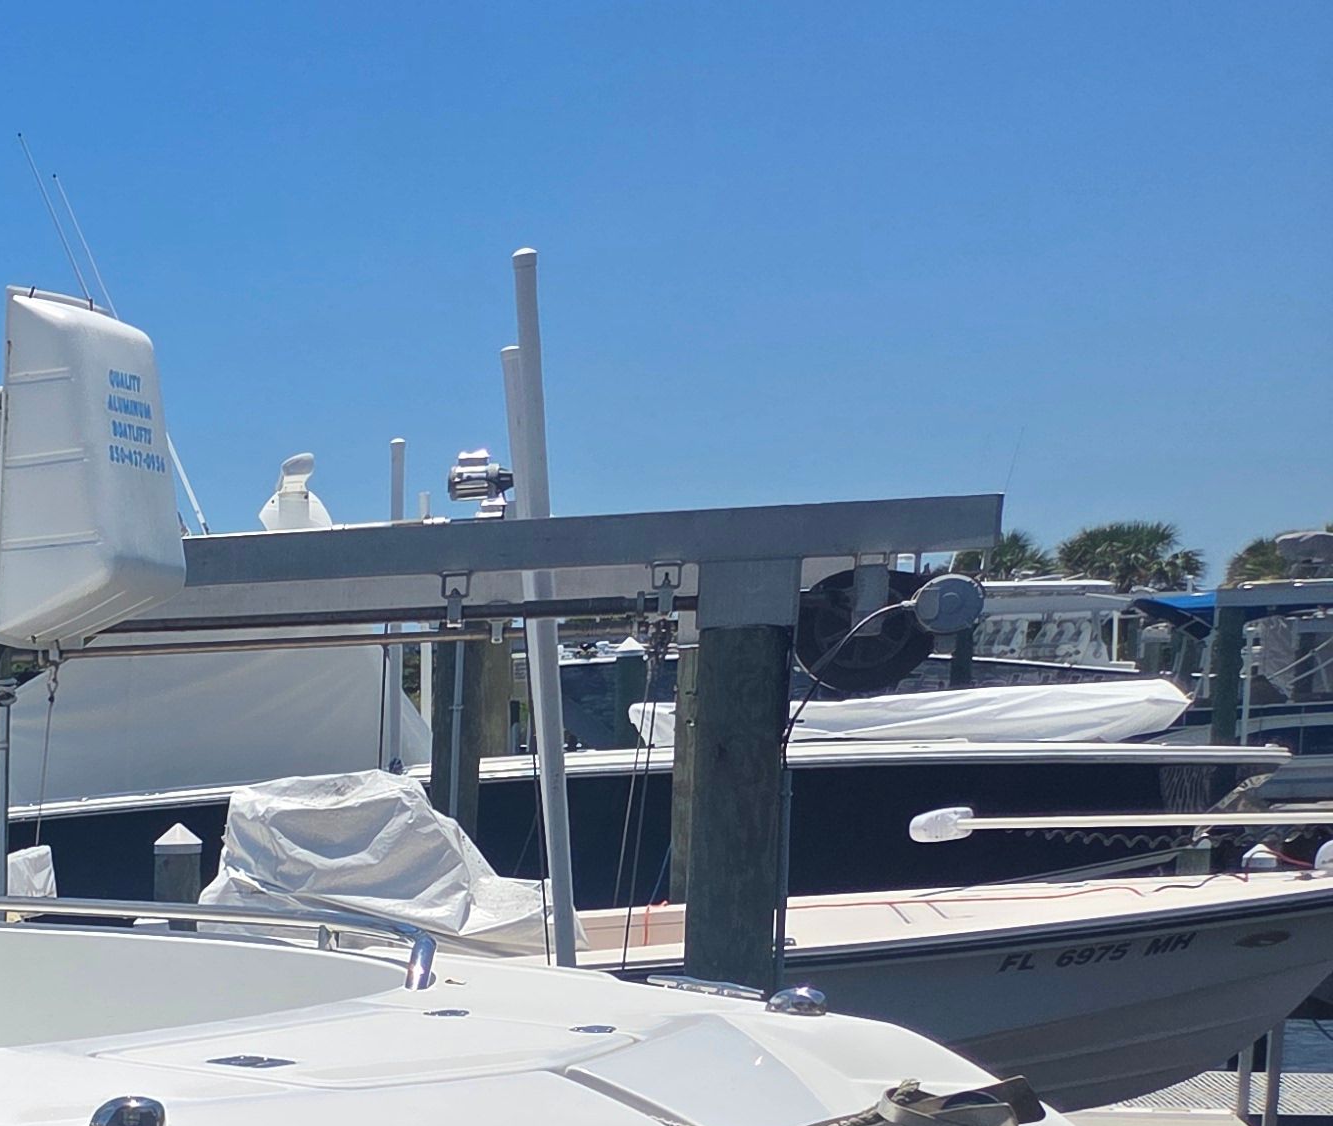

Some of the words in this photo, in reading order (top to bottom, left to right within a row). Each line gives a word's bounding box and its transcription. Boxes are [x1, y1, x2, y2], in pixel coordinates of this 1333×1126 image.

[109, 369, 141, 393] QUALITY
[108, 394, 152, 420] ALUMINUM
[112, 419, 152, 445] BOATLIFTS
[997, 953, 1035, 973] FL
[1055, 943, 1132, 968] 6975
